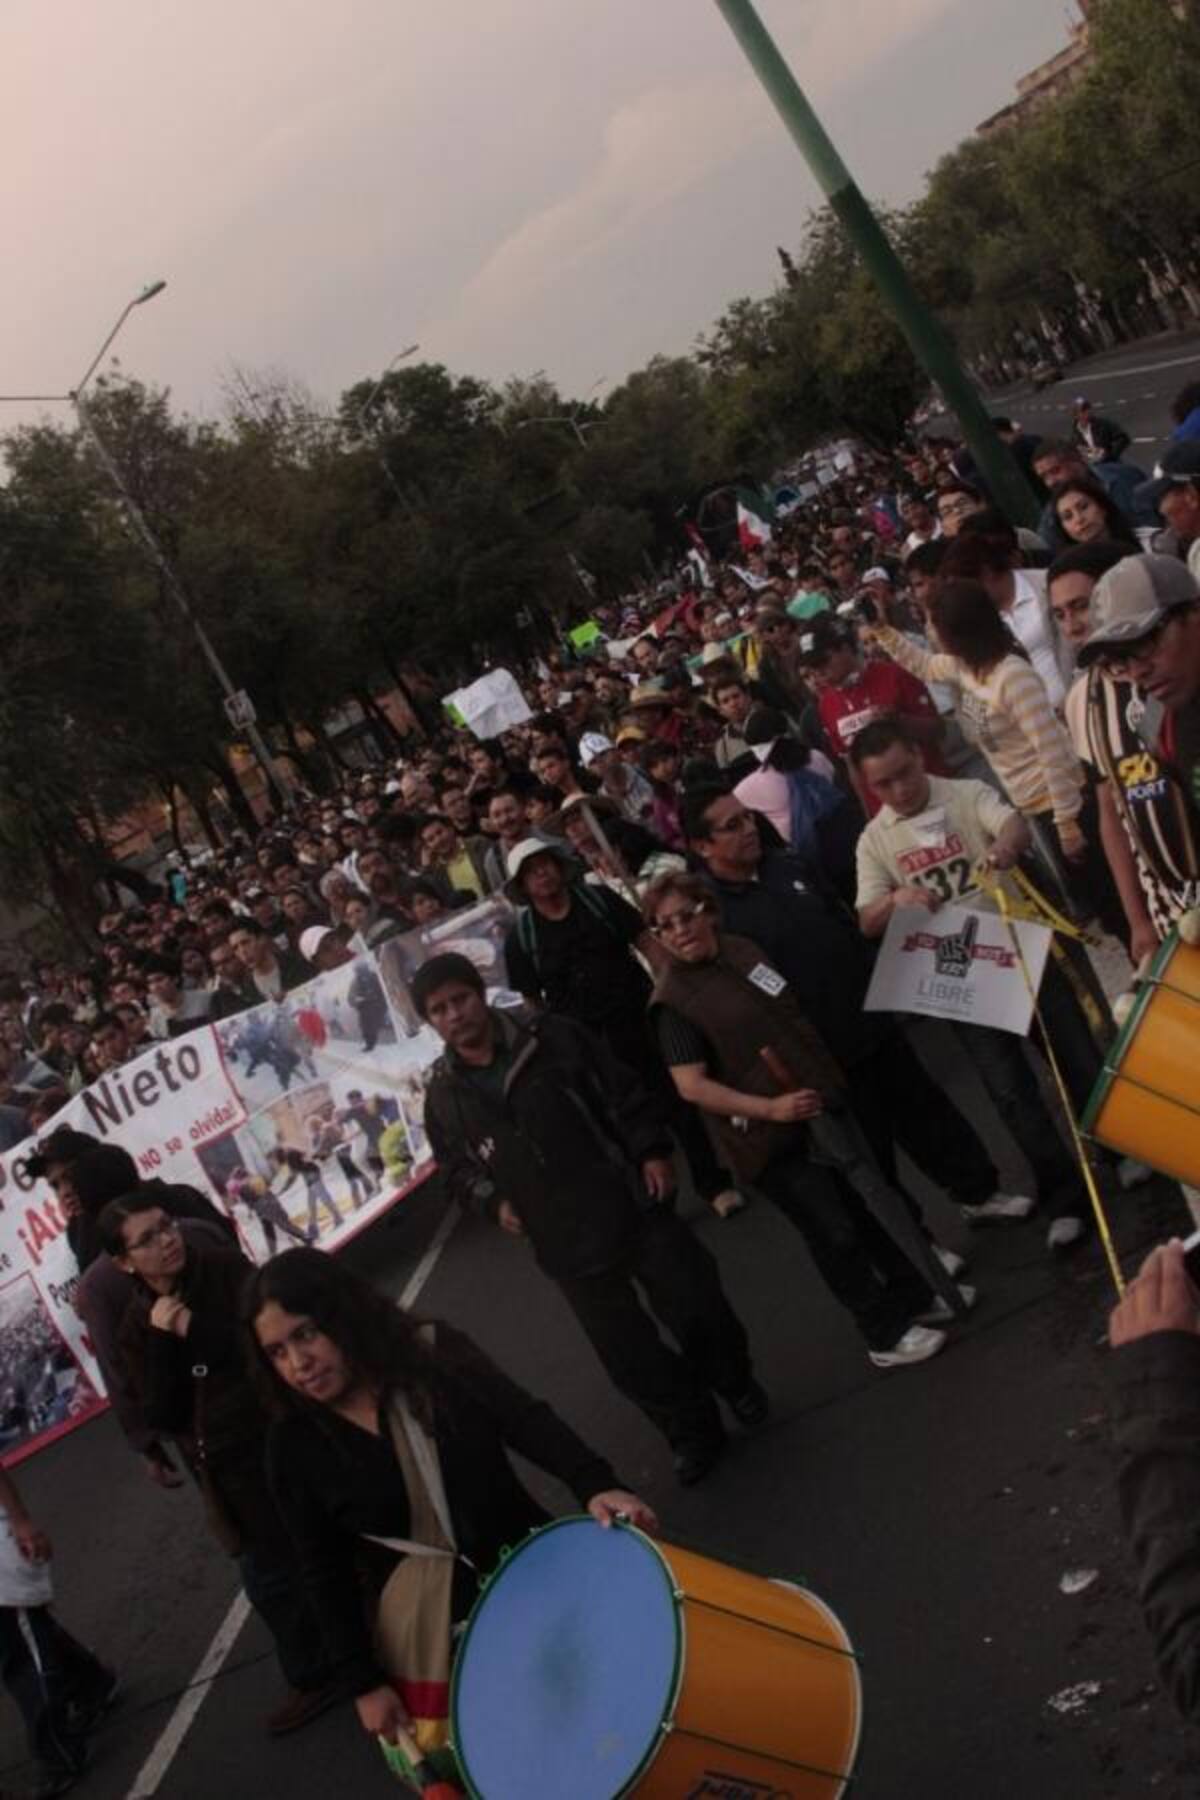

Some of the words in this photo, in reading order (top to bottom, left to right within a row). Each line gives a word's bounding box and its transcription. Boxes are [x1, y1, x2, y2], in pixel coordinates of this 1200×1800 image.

[917, 979, 975, 1004] LIBRE
[81, 1045, 200, 1136] Nieto
[138, 1148, 162, 1172] NO
[165, 1136, 183, 1155] se
